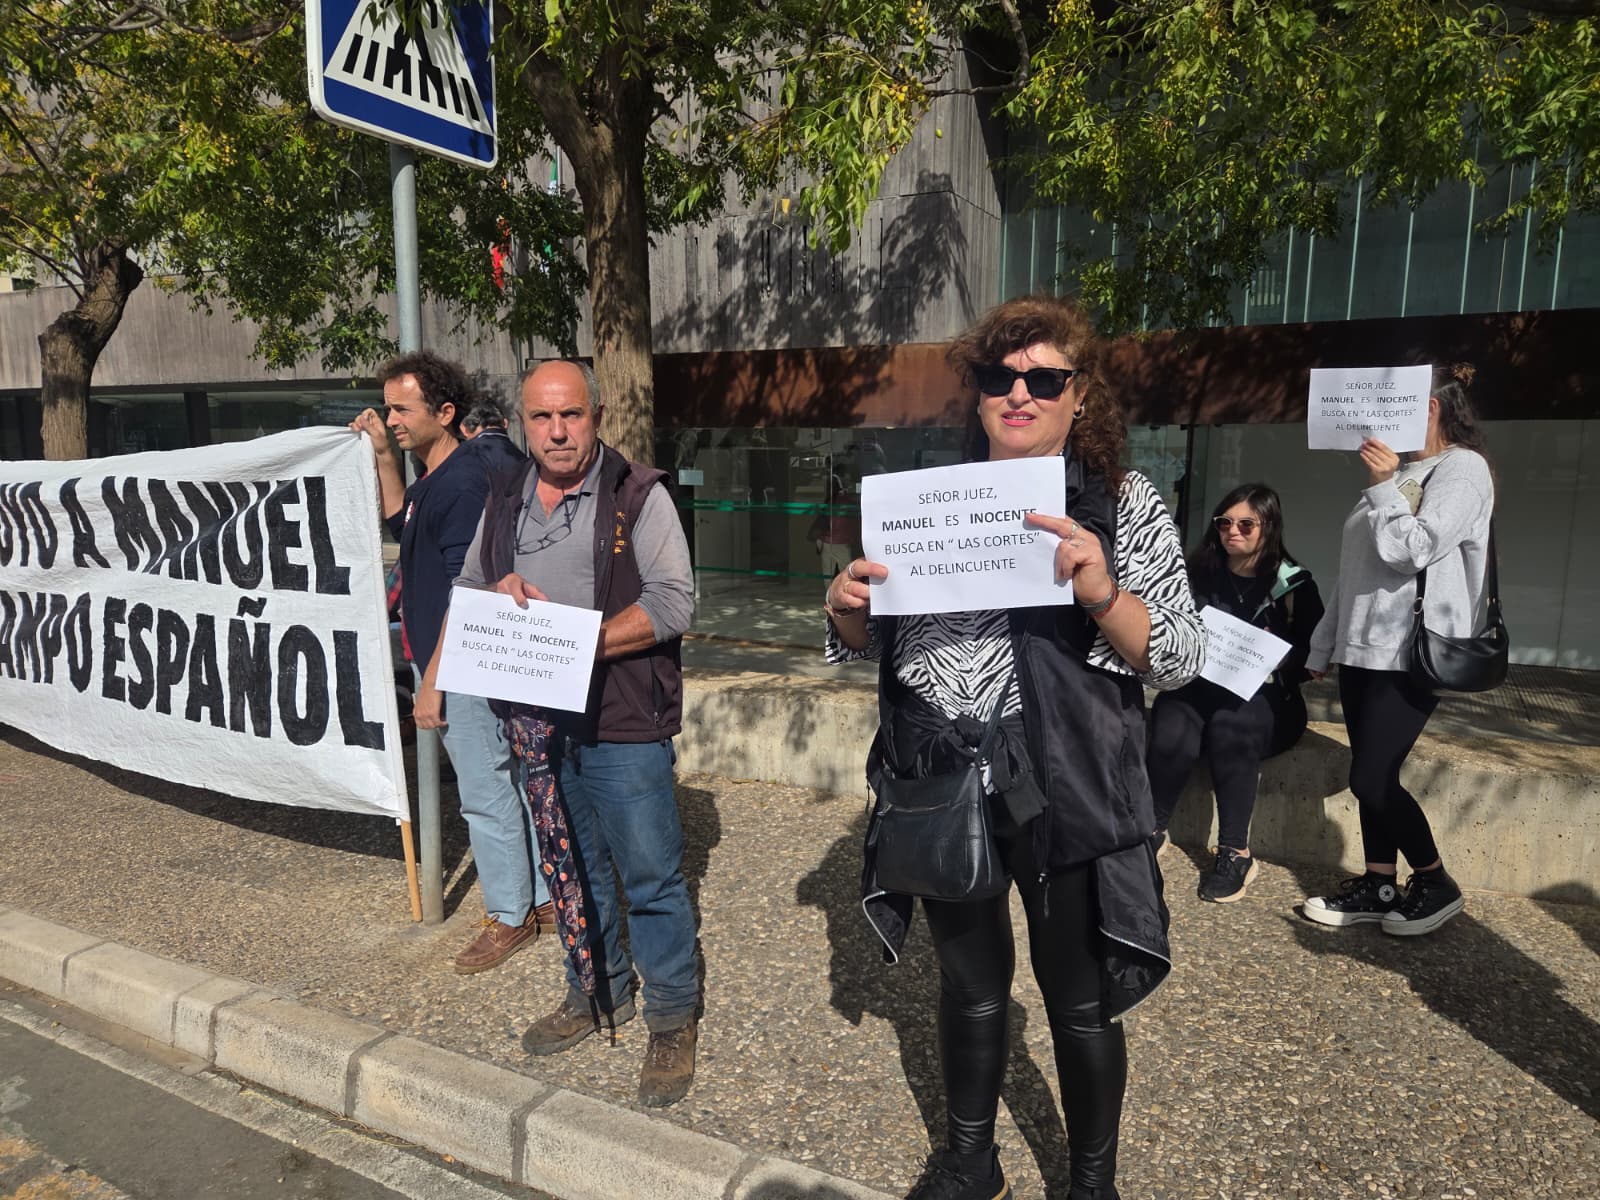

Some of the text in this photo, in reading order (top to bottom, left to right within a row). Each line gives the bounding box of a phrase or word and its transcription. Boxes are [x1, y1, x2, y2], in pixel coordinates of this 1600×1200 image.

[1345, 381, 1373, 390] SEÑOR
[1321, 395, 1419, 404] MANUEL ES INOCENTE,
[1321, 409, 1346, 417] BUSCA
[1366, 410, 1381, 418] LAS
[1335, 423, 1401, 432] AL DELINCUENTE
[918, 487, 998, 505] SEÑOR JUEZ,
[882, 517, 936, 532] MANUEL
[945, 514, 959, 527] ES
[59, 477, 112, 569] A
[101, 475, 351, 596] MANUEL
[884, 541, 925, 556] BUSCA
[928, 540, 944, 552] EN
[957, 537, 981, 550] LAS
[910, 558, 1017, 577] AL DELINCUENTE
[496, 611, 553, 629] SEÑOR JUEZ,
[463, 623, 579, 651] MANUEL ES INOCENTE,
[461, 640, 493, 653] BUSCA
[495, 646, 508, 655] EN
[517, 648, 533, 659] LAS
[101, 595, 386, 752] ESPAÑOL
[477, 660, 554, 680] AL DELINCUENTE
